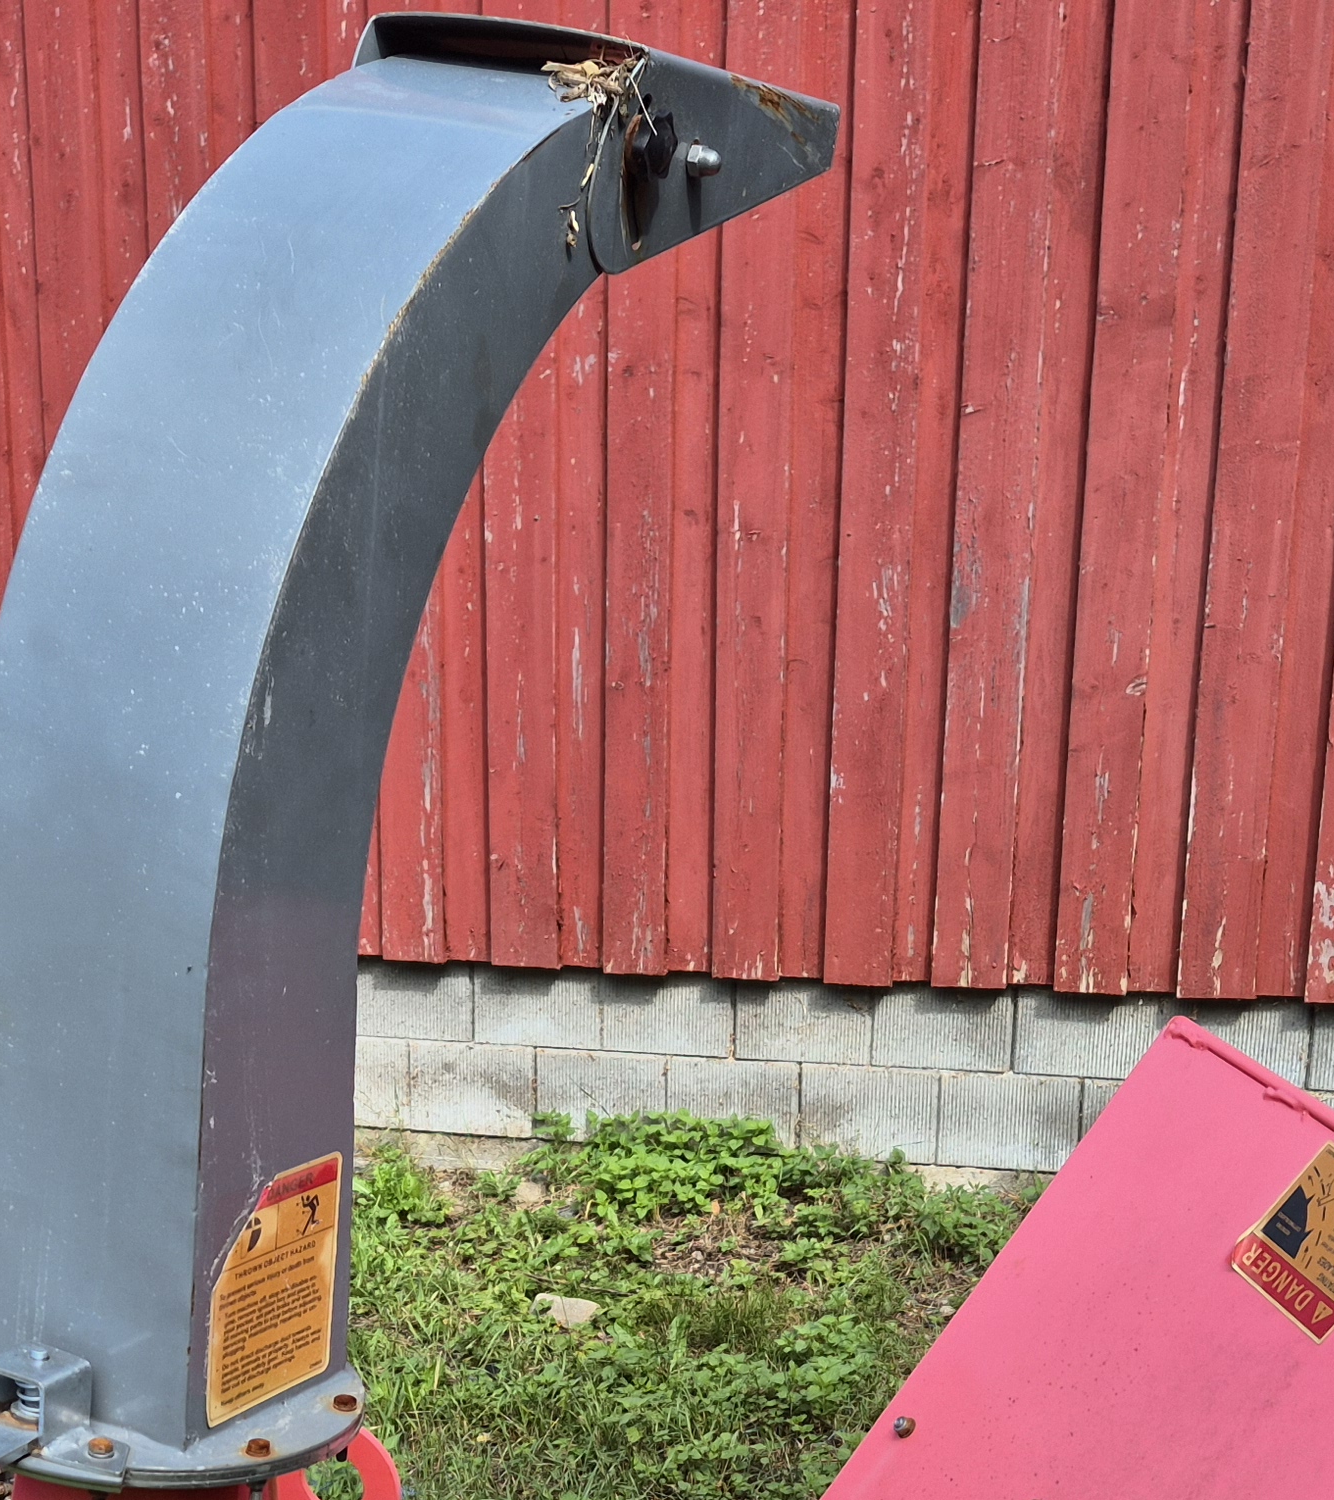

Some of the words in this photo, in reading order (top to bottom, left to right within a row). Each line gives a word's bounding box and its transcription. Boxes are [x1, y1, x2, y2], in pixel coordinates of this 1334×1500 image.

[267, 1172, 314, 1201] DANGER
[235, 1262, 261, 1279] THROWN
[264, 1251, 287, 1267] OBJECT
[290, 1239, 315, 1256] HAZARD
[1241, 1243, 1313, 1310] DANGER
